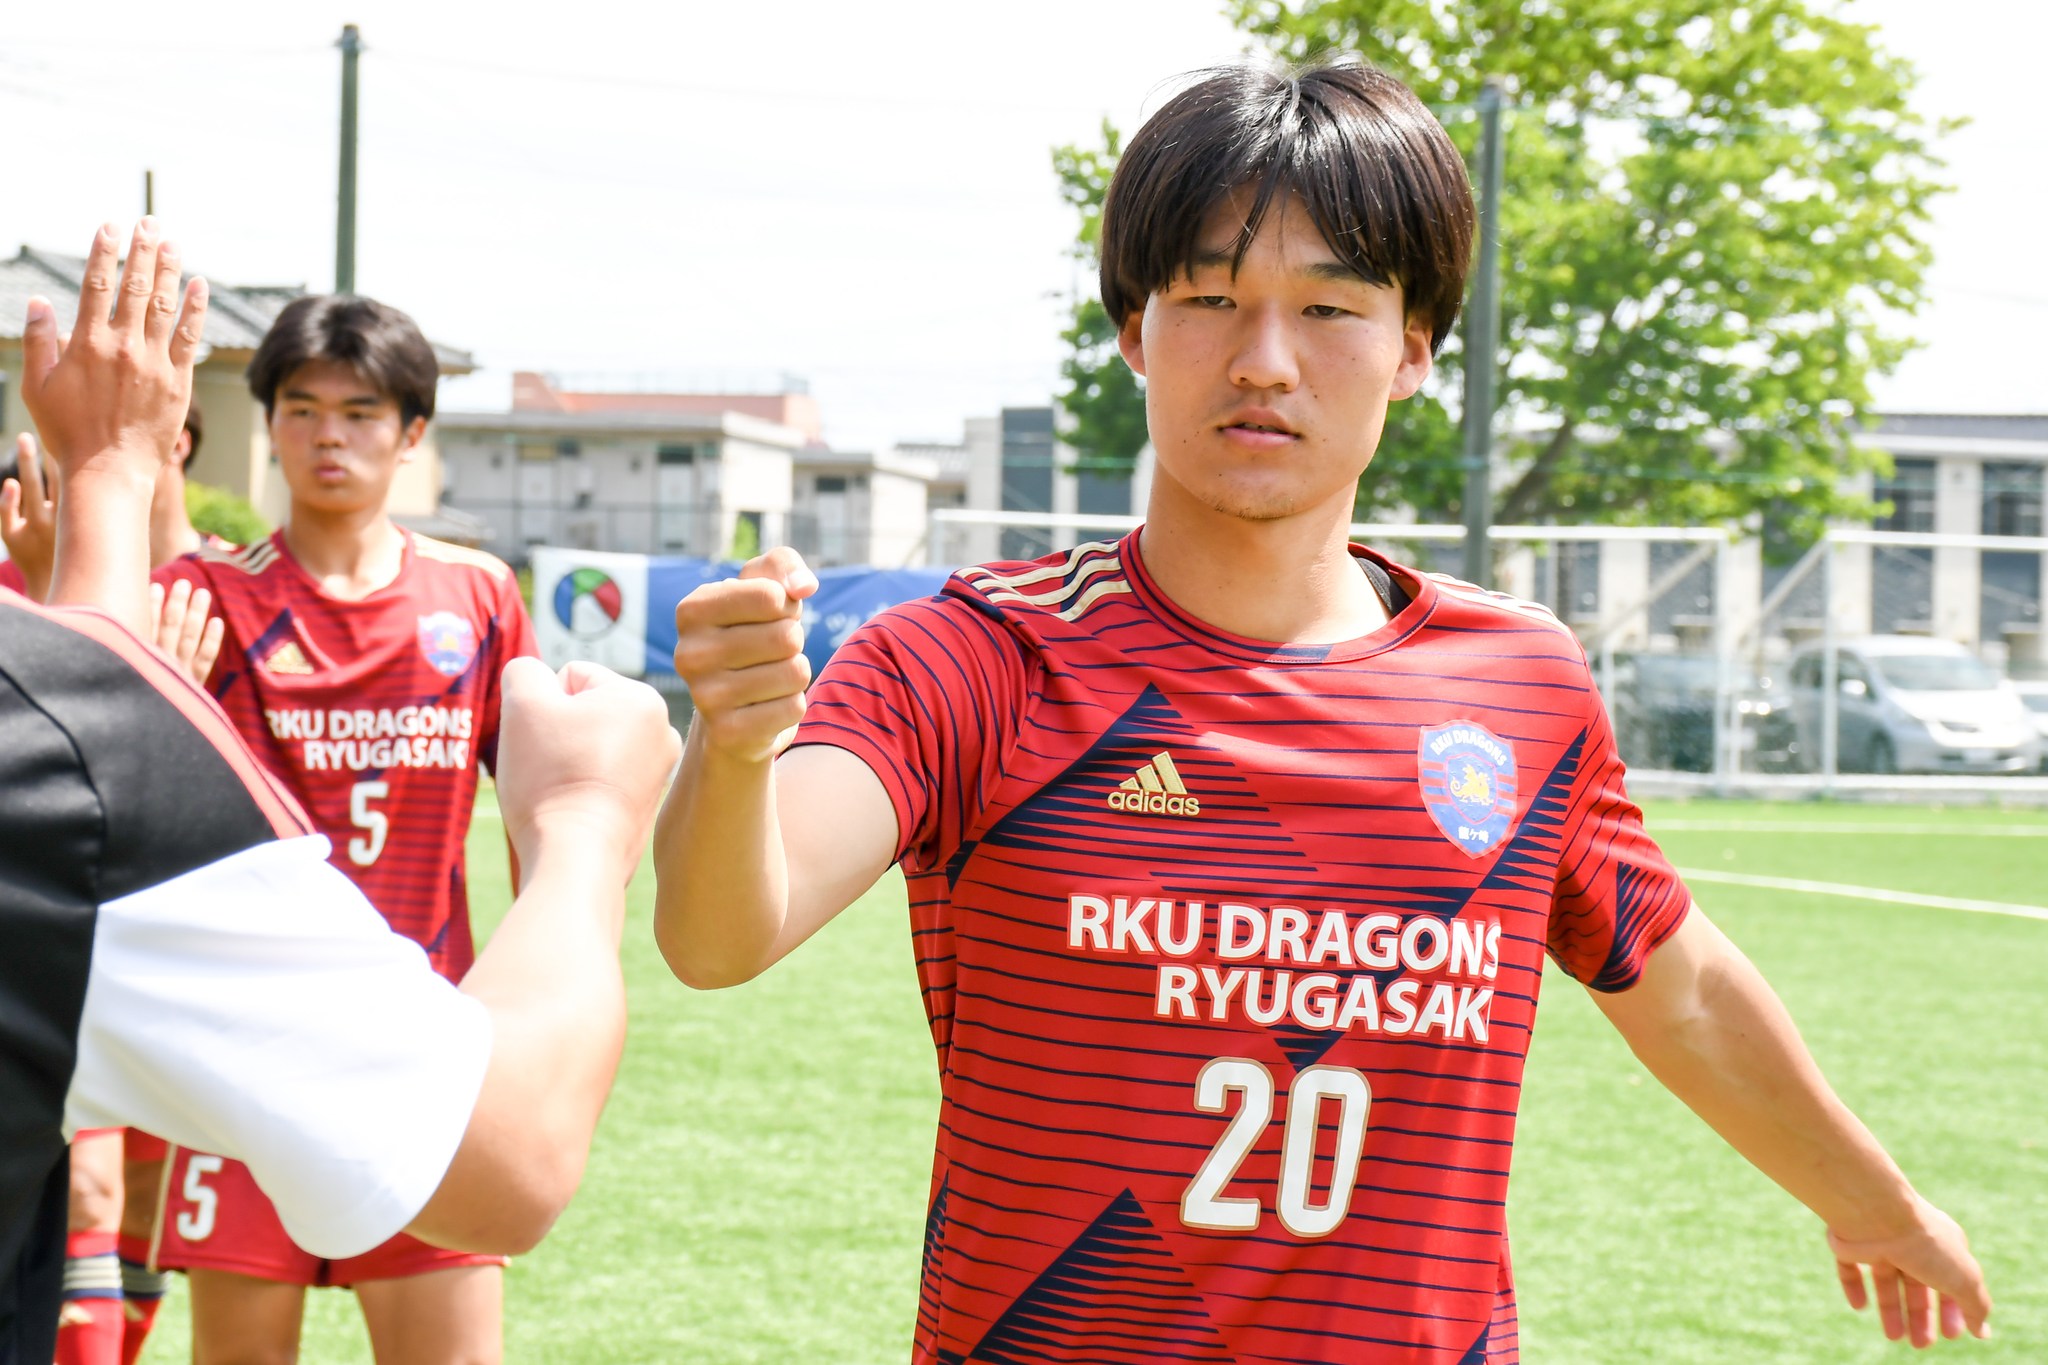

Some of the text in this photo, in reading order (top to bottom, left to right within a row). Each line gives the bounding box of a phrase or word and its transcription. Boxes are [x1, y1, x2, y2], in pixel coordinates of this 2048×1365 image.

[303, 738, 470, 771] RYUGASAK
[328, 705, 473, 740] DRAGONS
[1430, 729, 1507, 766] RKU DRAGONS
[348, 780, 390, 867] 5
[1107, 788, 1201, 817] adidas
[1068, 893, 1502, 980] RKU DRAGONS
[1155, 964, 1495, 1043] RYUGASAK
[1179, 1056, 1373, 1239] 20
[176, 1154, 224, 1241] 5
